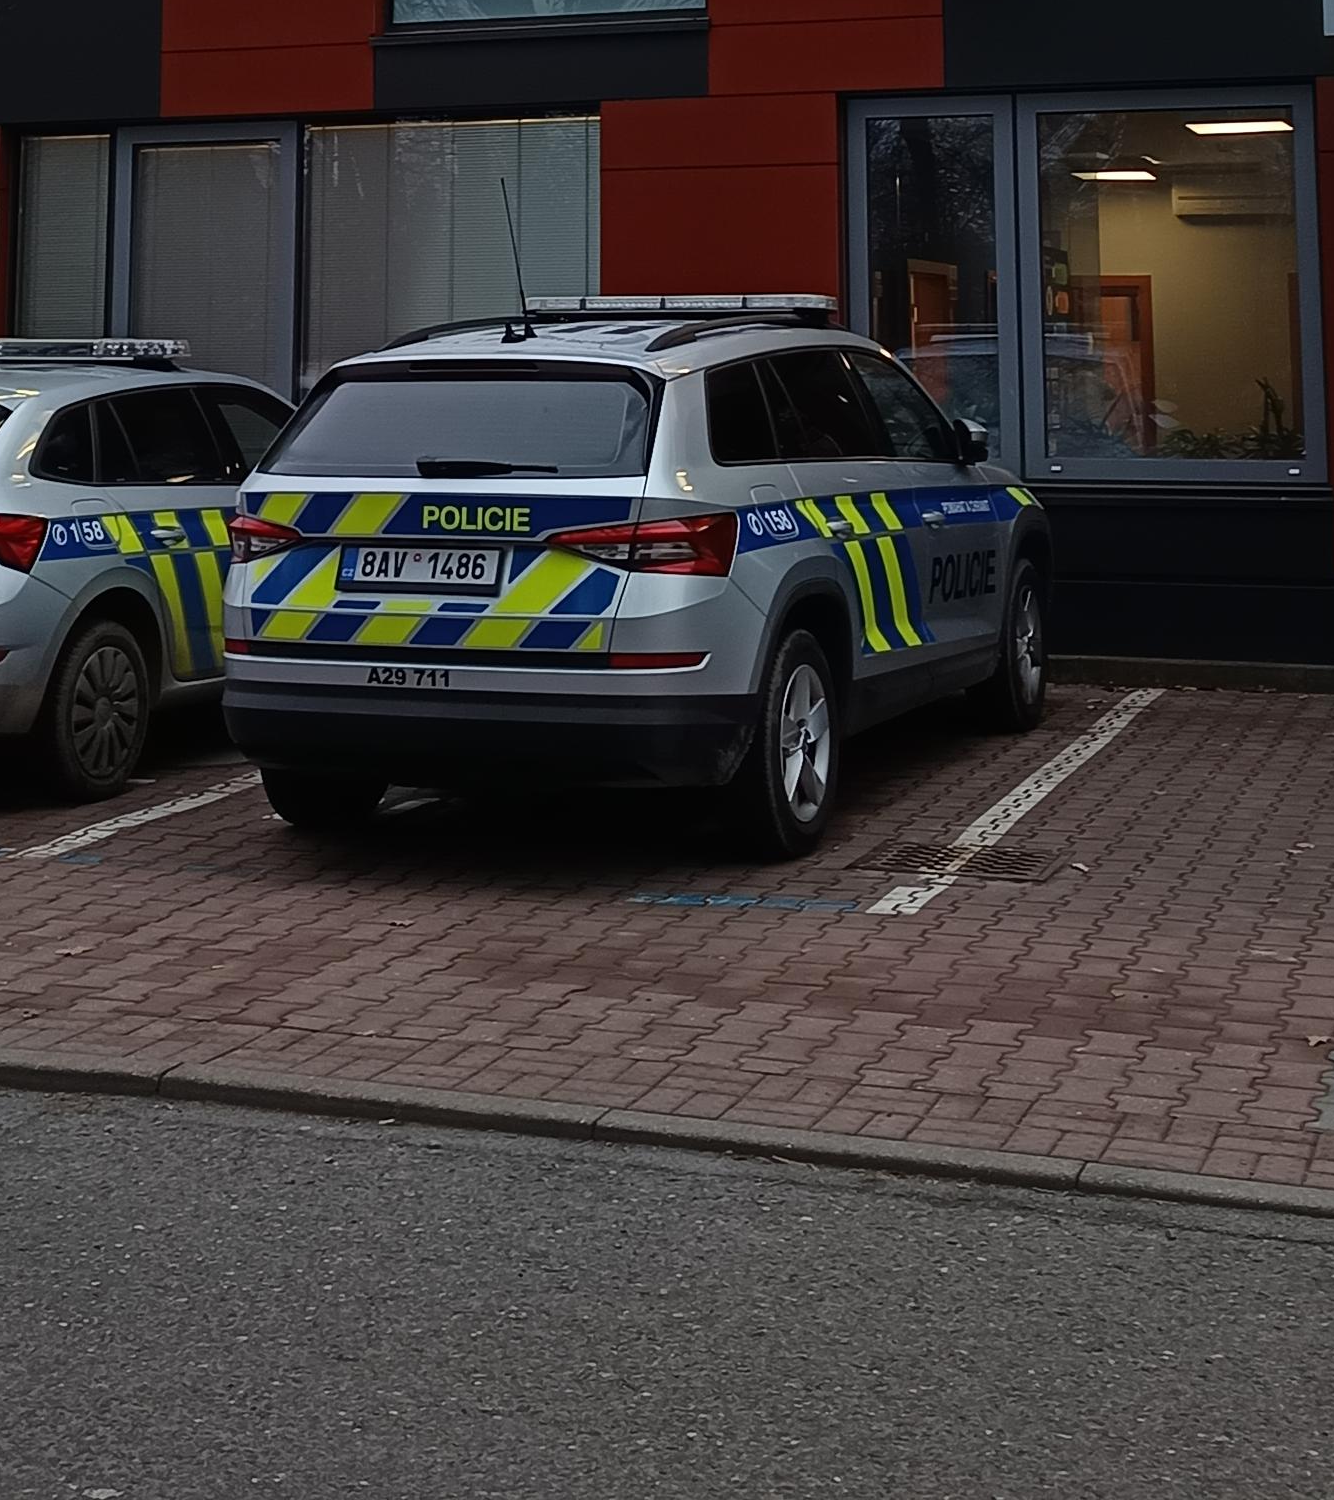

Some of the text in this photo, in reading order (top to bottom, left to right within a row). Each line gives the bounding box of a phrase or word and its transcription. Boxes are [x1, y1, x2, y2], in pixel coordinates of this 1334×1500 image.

[423, 506, 530, 531] POLICIE
[764, 510, 792, 531] 158
[70, 521, 104, 543] 158
[361, 551, 487, 580] 8AV 1486
[929, 550, 995, 604] POLICIE
[367, 667, 449, 687] A29 711
